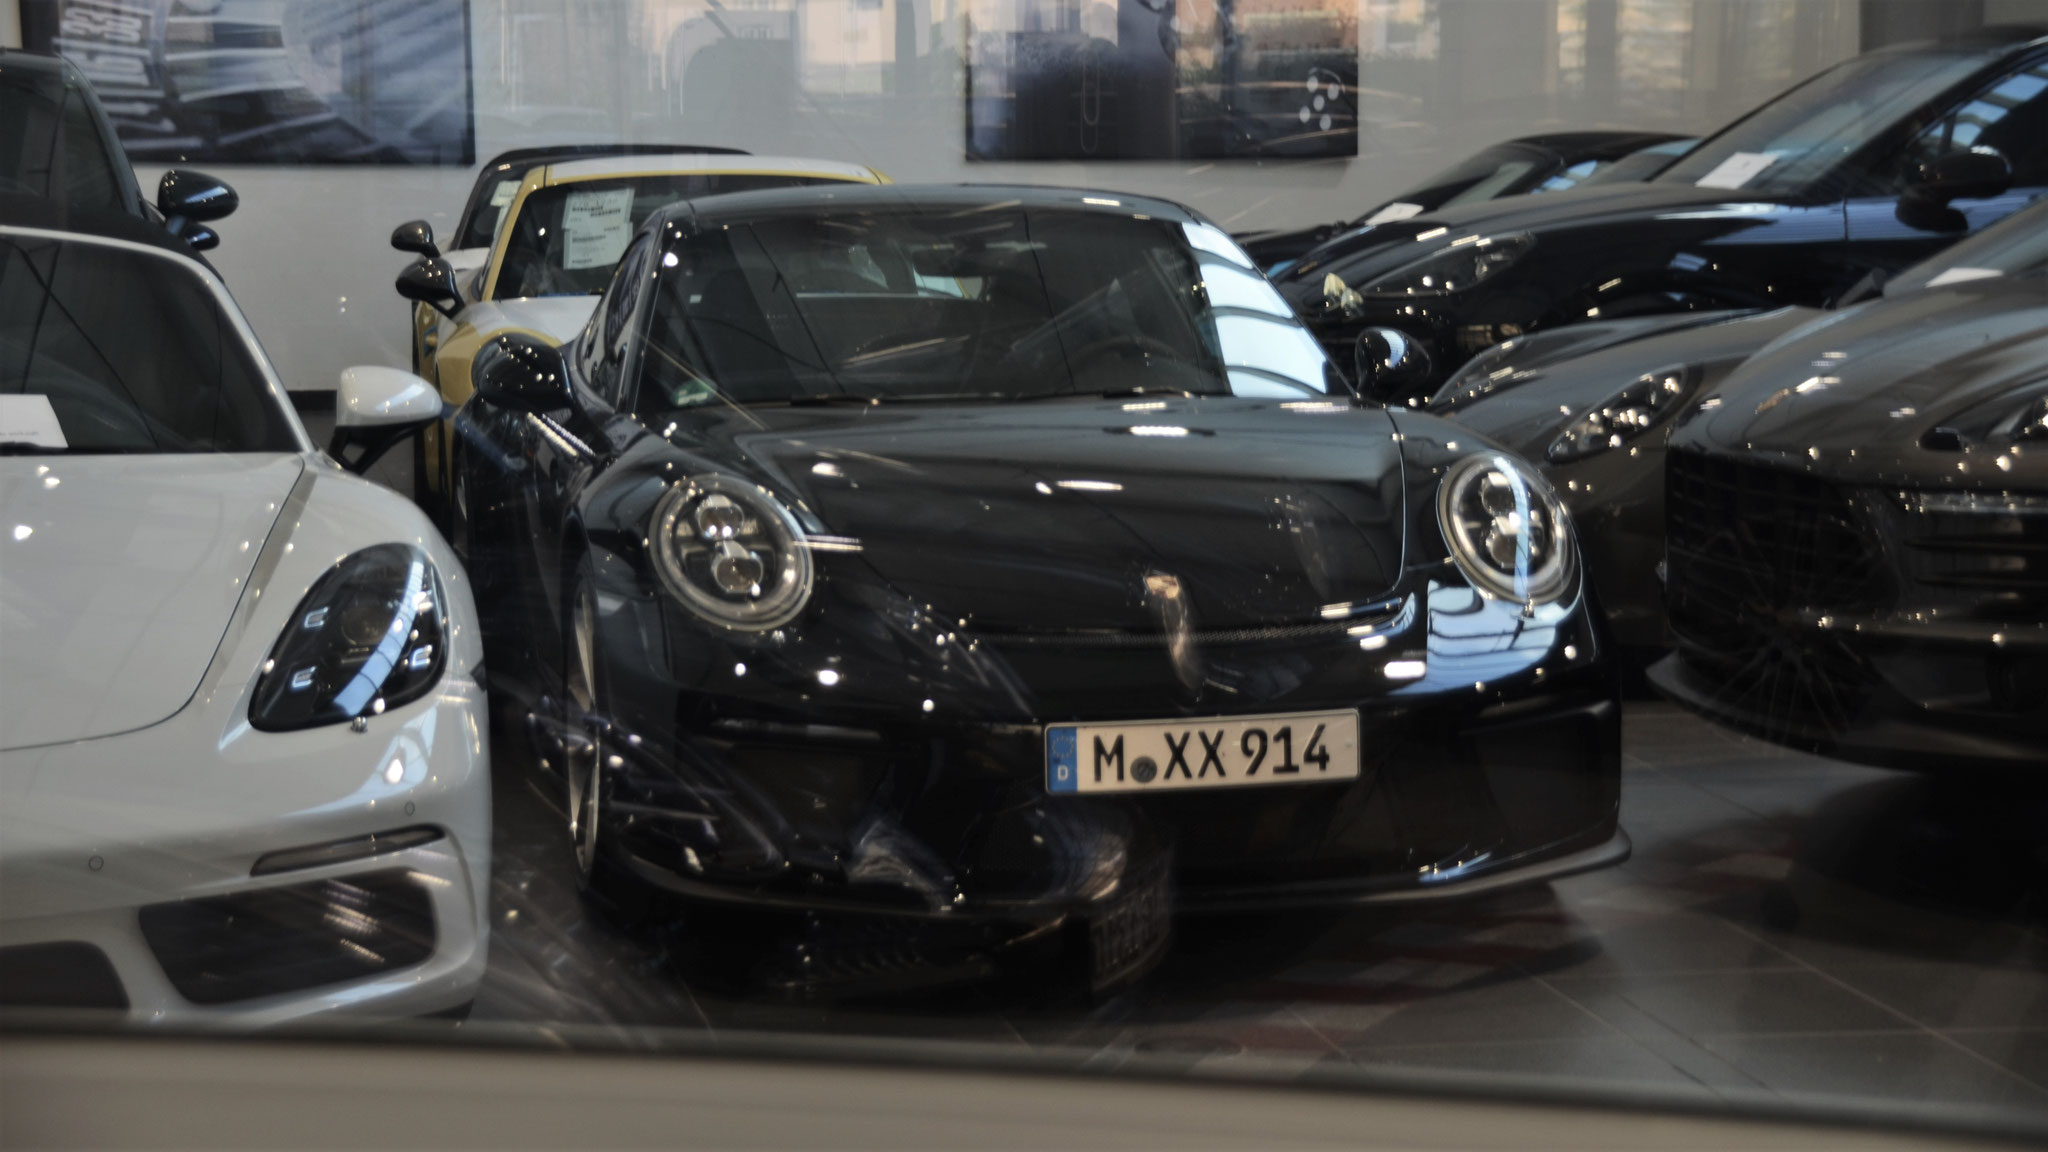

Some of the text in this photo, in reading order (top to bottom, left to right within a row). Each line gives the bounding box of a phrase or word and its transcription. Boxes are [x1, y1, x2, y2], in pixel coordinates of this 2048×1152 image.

[1093, 724, 1330, 782] M XX 914
[1058, 764, 1069, 781] D
